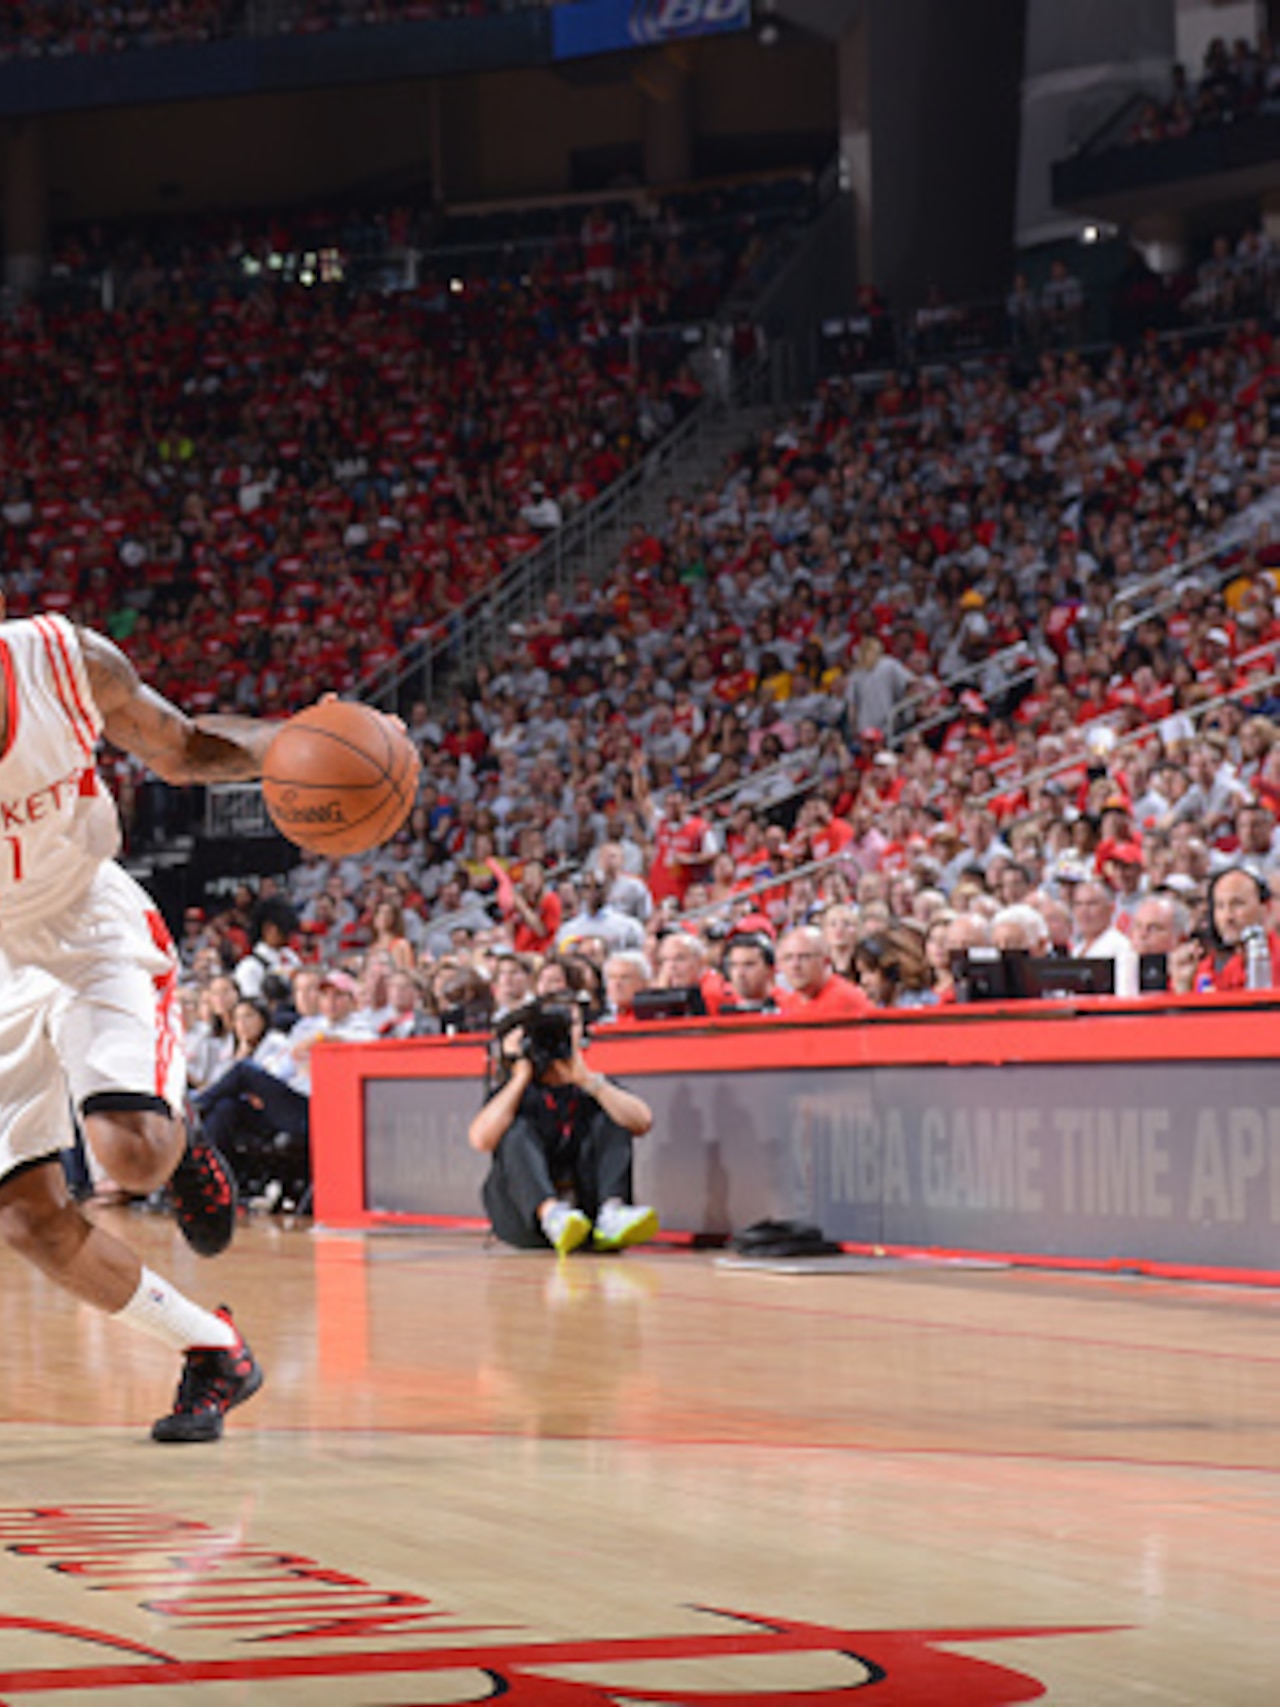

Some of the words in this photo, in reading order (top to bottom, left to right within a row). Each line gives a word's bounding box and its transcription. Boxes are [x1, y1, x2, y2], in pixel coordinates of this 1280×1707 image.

[4, 836, 24, 883] 1
[830, 1109, 911, 1205] NBA
[921, 1108, 1043, 1213] GAME
[1054, 1108, 1172, 1218] TIME
